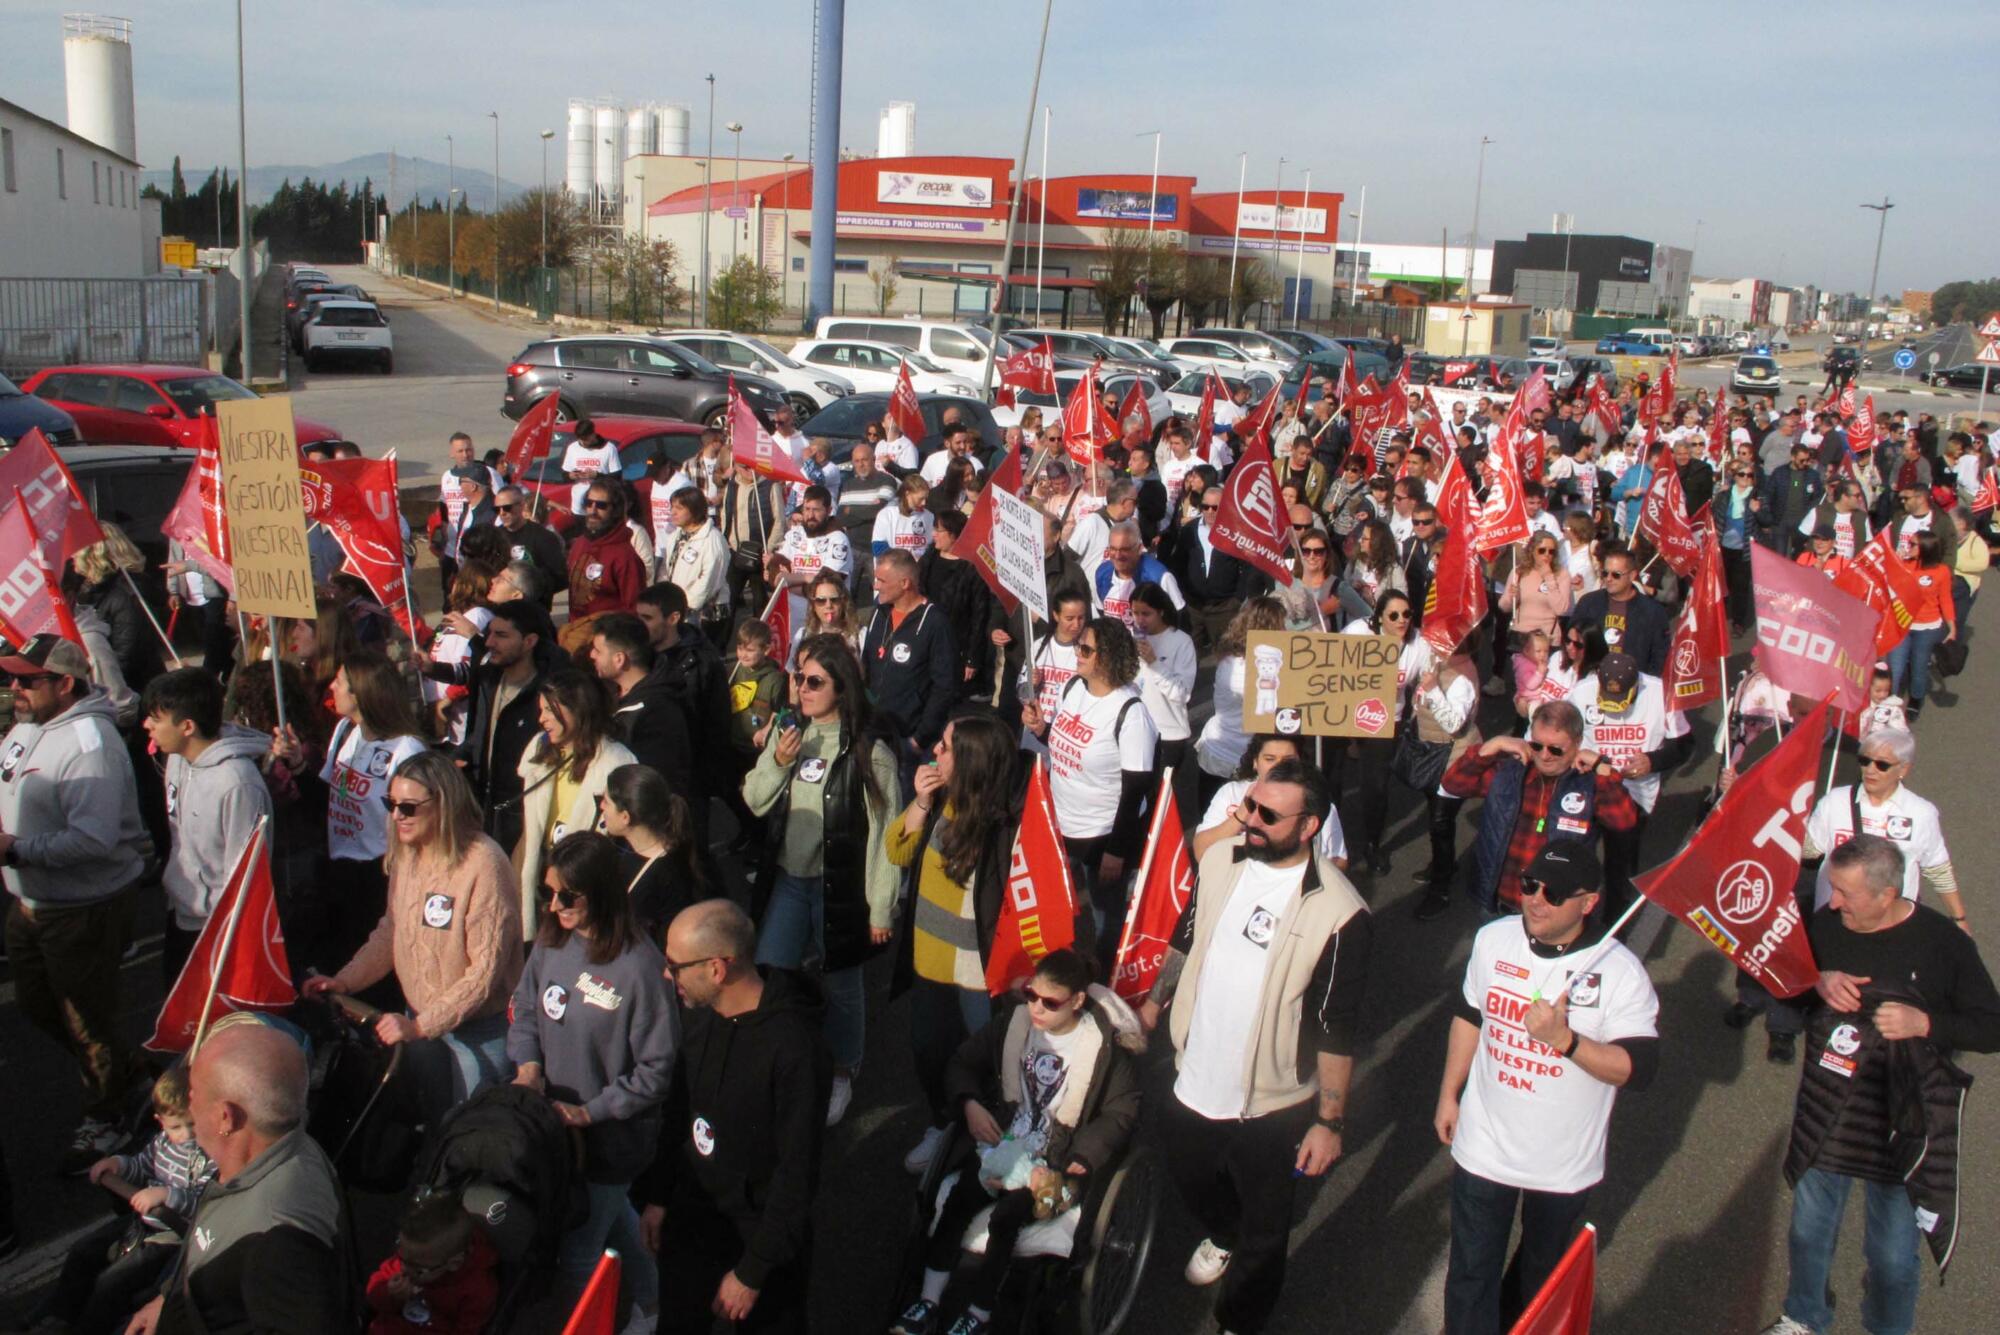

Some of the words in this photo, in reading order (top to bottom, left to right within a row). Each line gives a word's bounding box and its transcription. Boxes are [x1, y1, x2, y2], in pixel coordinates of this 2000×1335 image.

[915, 221, 964, 230] INDUSTRIAL
[1445, 364, 1469, 373] CNT
[1457, 377, 1477, 385] AIT
[222, 416, 292, 465] VUESTRA
[228, 473, 299, 516] GESTIÓN
[231, 525, 305, 558] NUESTRA
[236, 567, 310, 609] RUINA!
[1289, 635, 1400, 671] BIMBO
[1306, 673, 1384, 697] SENSE
[1295, 701, 1348, 727] TU
[1594, 726, 1647, 742] BIMBO
[1057, 739, 1082, 760] LLEVA
[1488, 1024, 1505, 1043] SE
[1487, 1043, 1564, 1078] NUESTRO
[1498, 1070, 1537, 1094] PAN.
